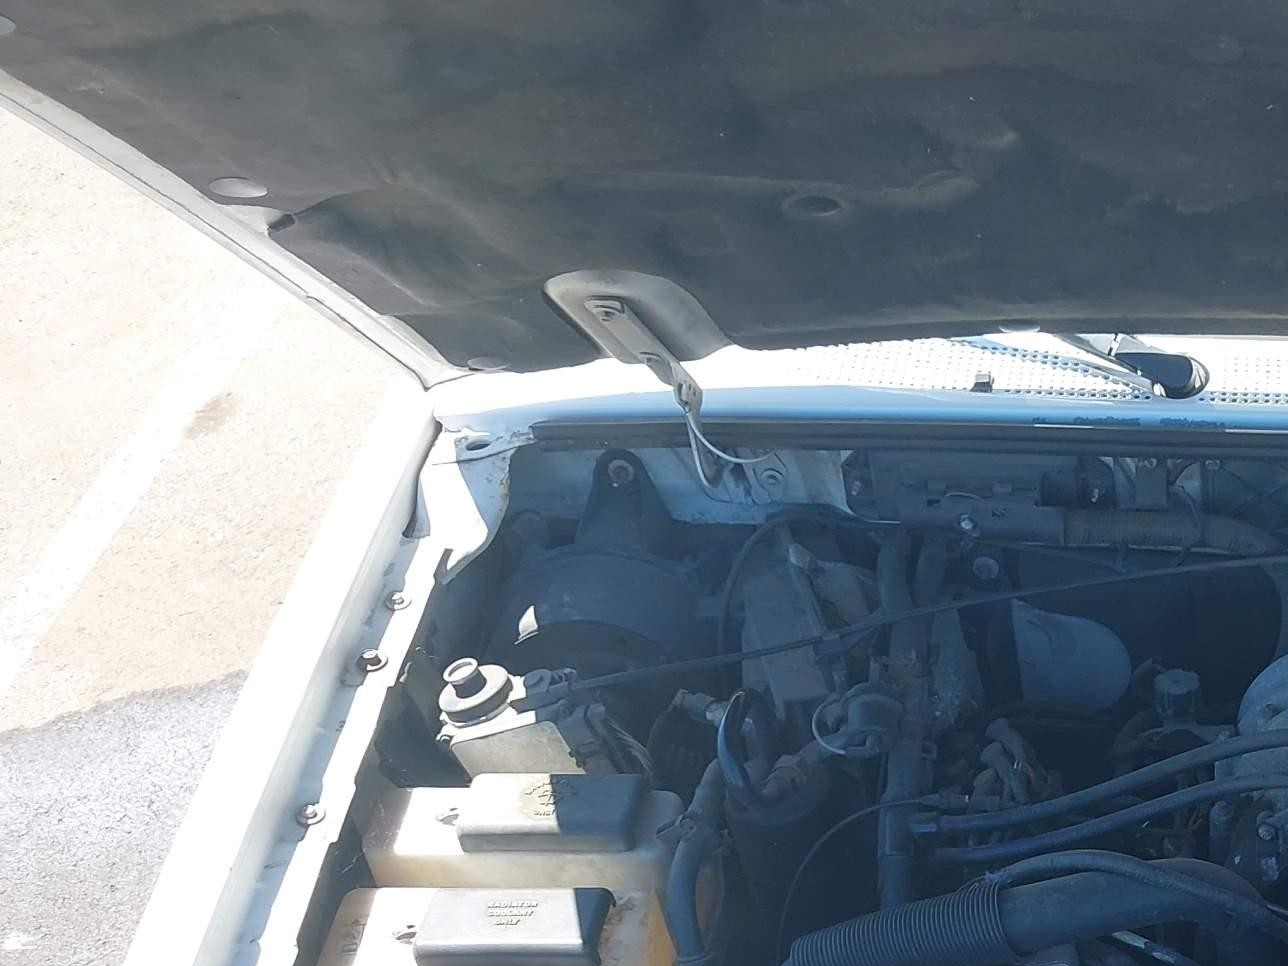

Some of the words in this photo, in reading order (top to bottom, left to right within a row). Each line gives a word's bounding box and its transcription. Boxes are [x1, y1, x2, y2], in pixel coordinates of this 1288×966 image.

[488, 900, 538, 908] RADIATOR
[488, 910, 534, 918] COOLANT
[496, 918, 520, 926] ONLY
